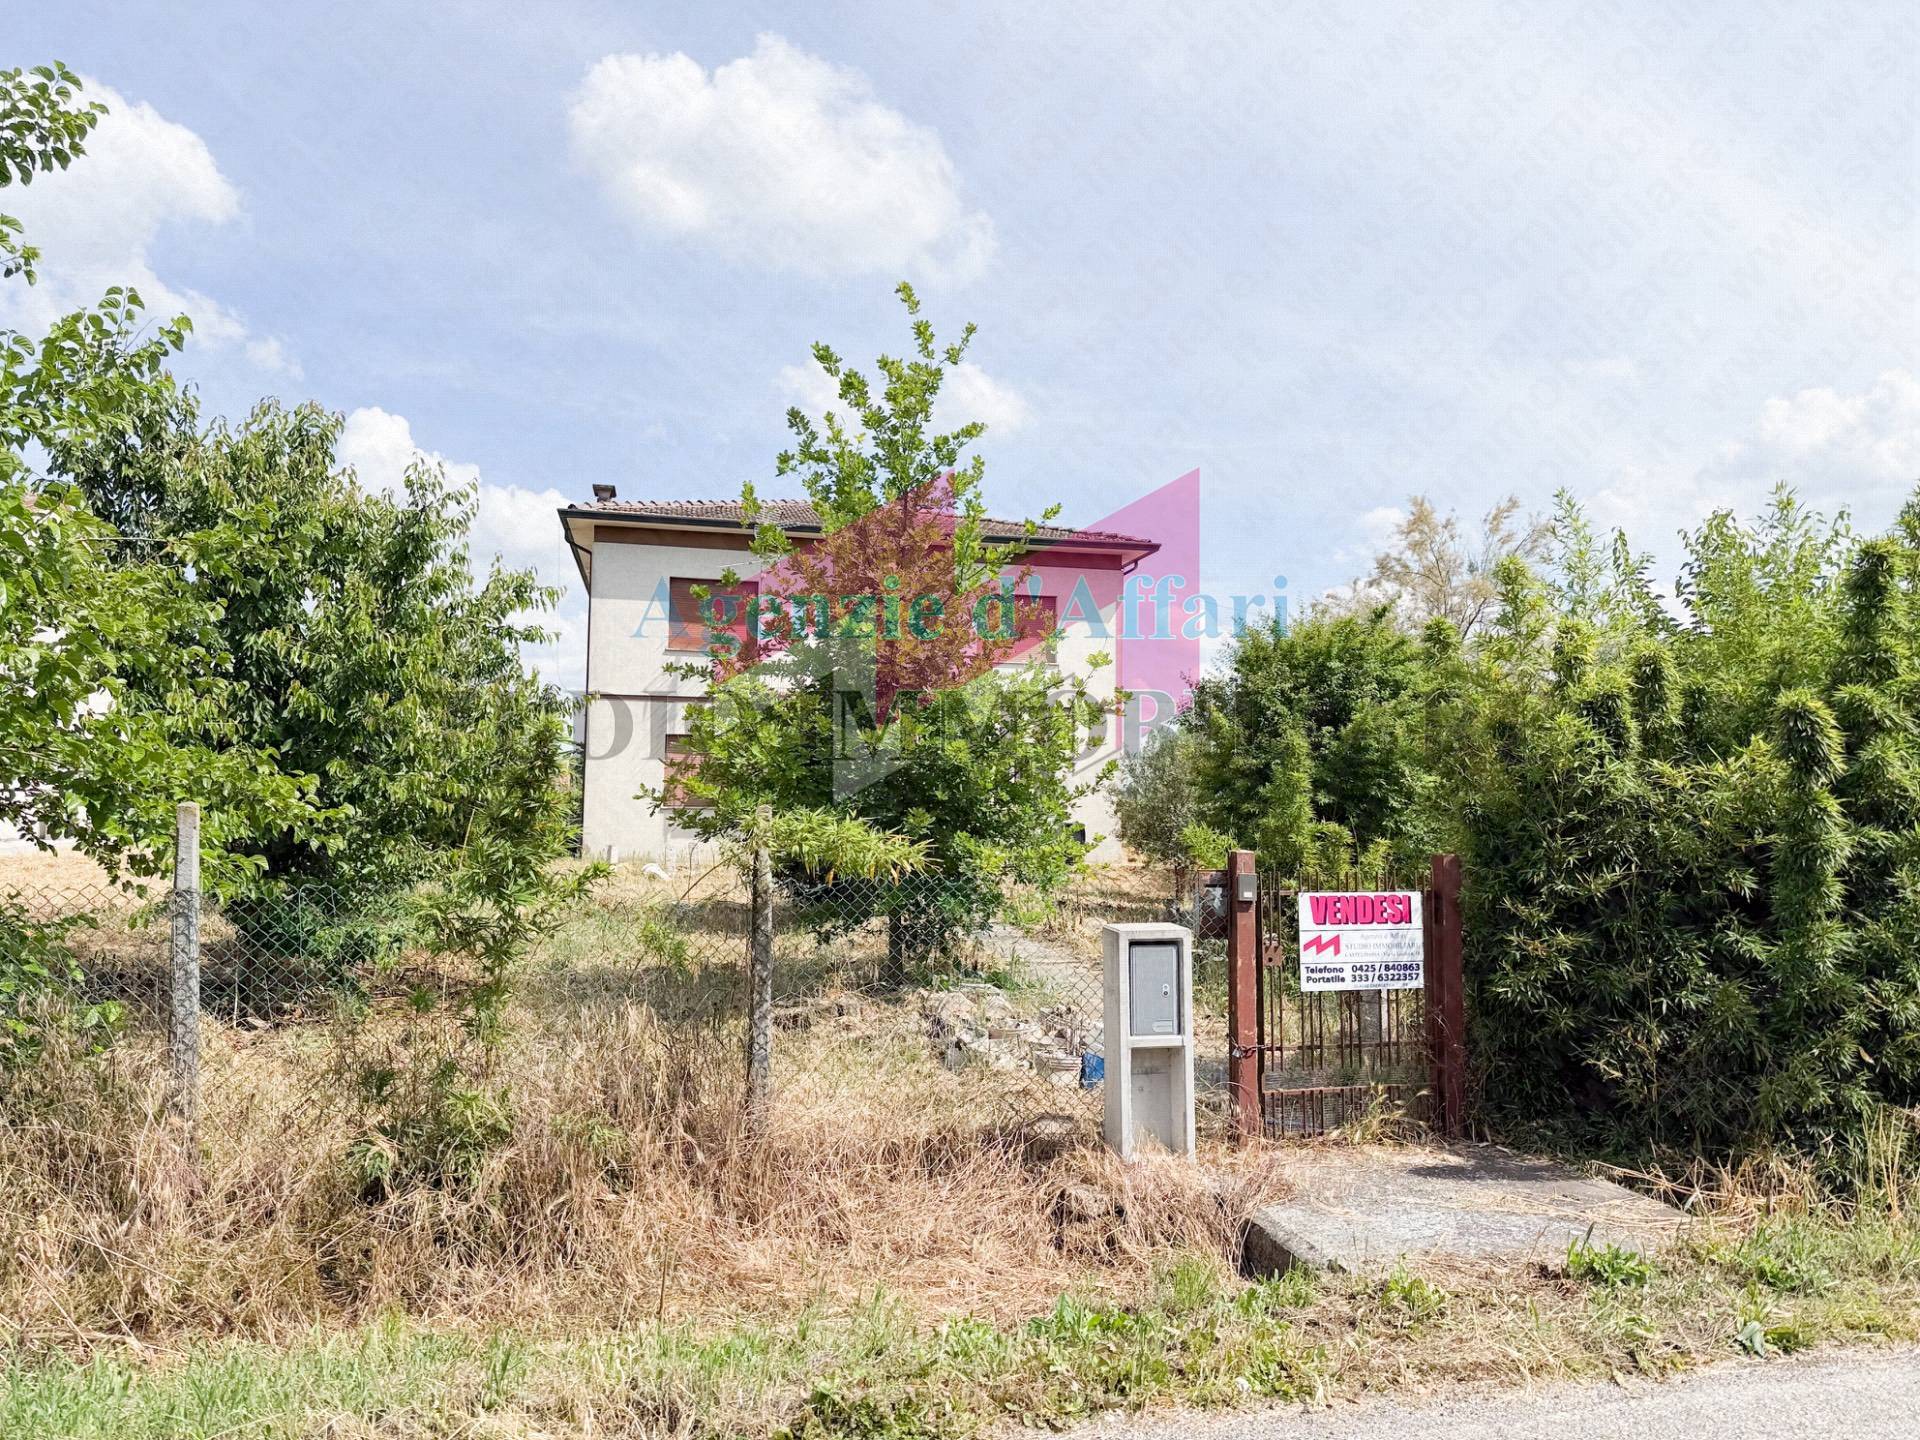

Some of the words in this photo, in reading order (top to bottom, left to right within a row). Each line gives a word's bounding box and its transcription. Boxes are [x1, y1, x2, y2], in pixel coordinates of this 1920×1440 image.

[1309, 894, 1412, 926] VENDESI
[1305, 966, 1345, 974] Telefono
[1352, 964, 1376, 973] 0425
[1384, 963, 1420, 972] 840863
[1306, 975, 1346, 984] Portatile
[1351, 974, 1369, 983] 333
[1378, 972, 1420, 982] 6322357
